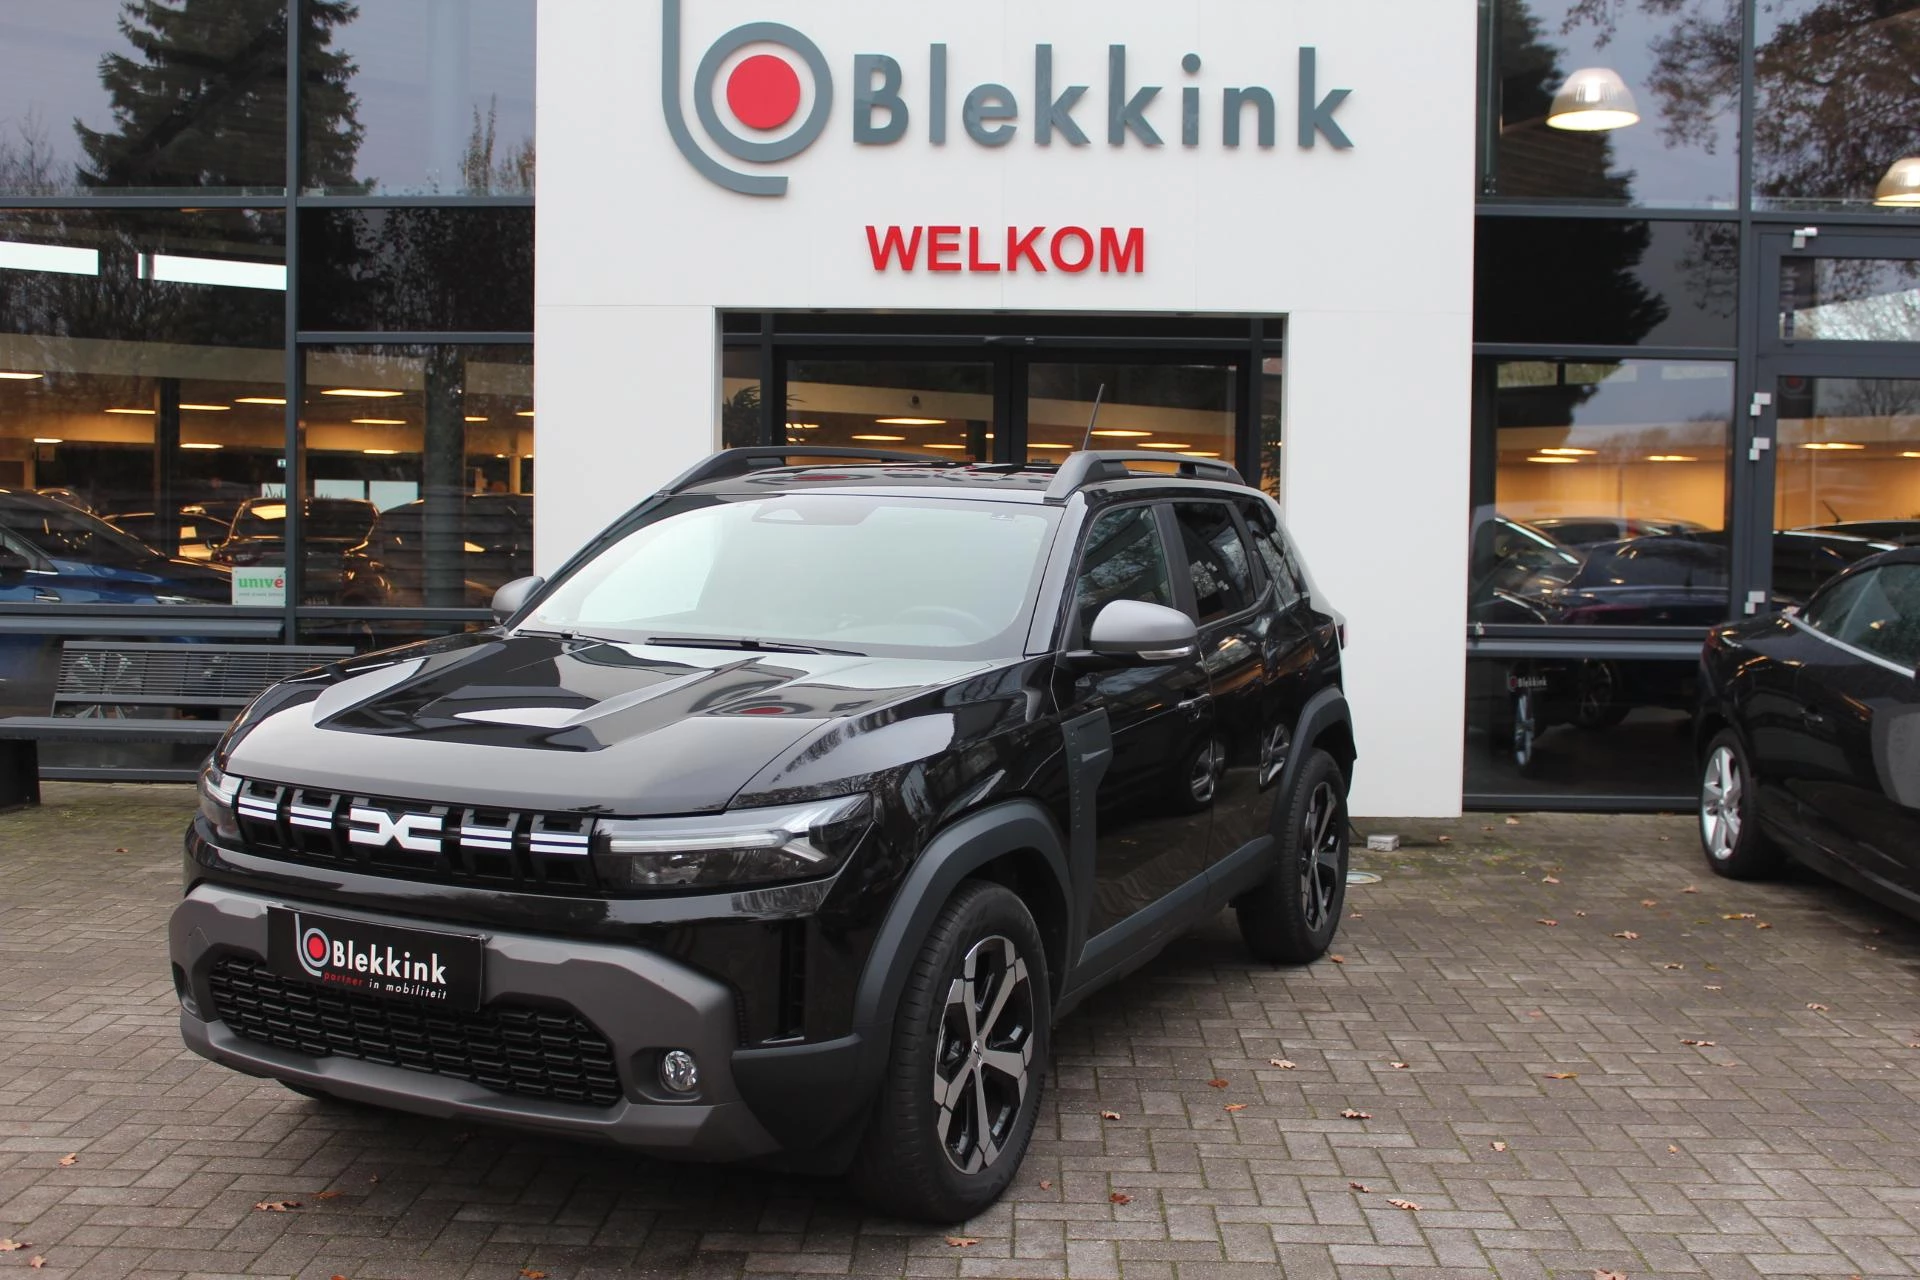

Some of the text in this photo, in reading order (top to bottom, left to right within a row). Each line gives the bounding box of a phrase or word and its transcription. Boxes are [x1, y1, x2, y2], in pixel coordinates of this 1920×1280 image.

[852, 43, 1355, 149] Blekkink
[865, 225, 1145, 273] WELKOM
[238, 574, 284, 588] univé
[332, 940, 447, 985] Blekkink
[323, 971, 447, 1000] partner in mobiliteit
